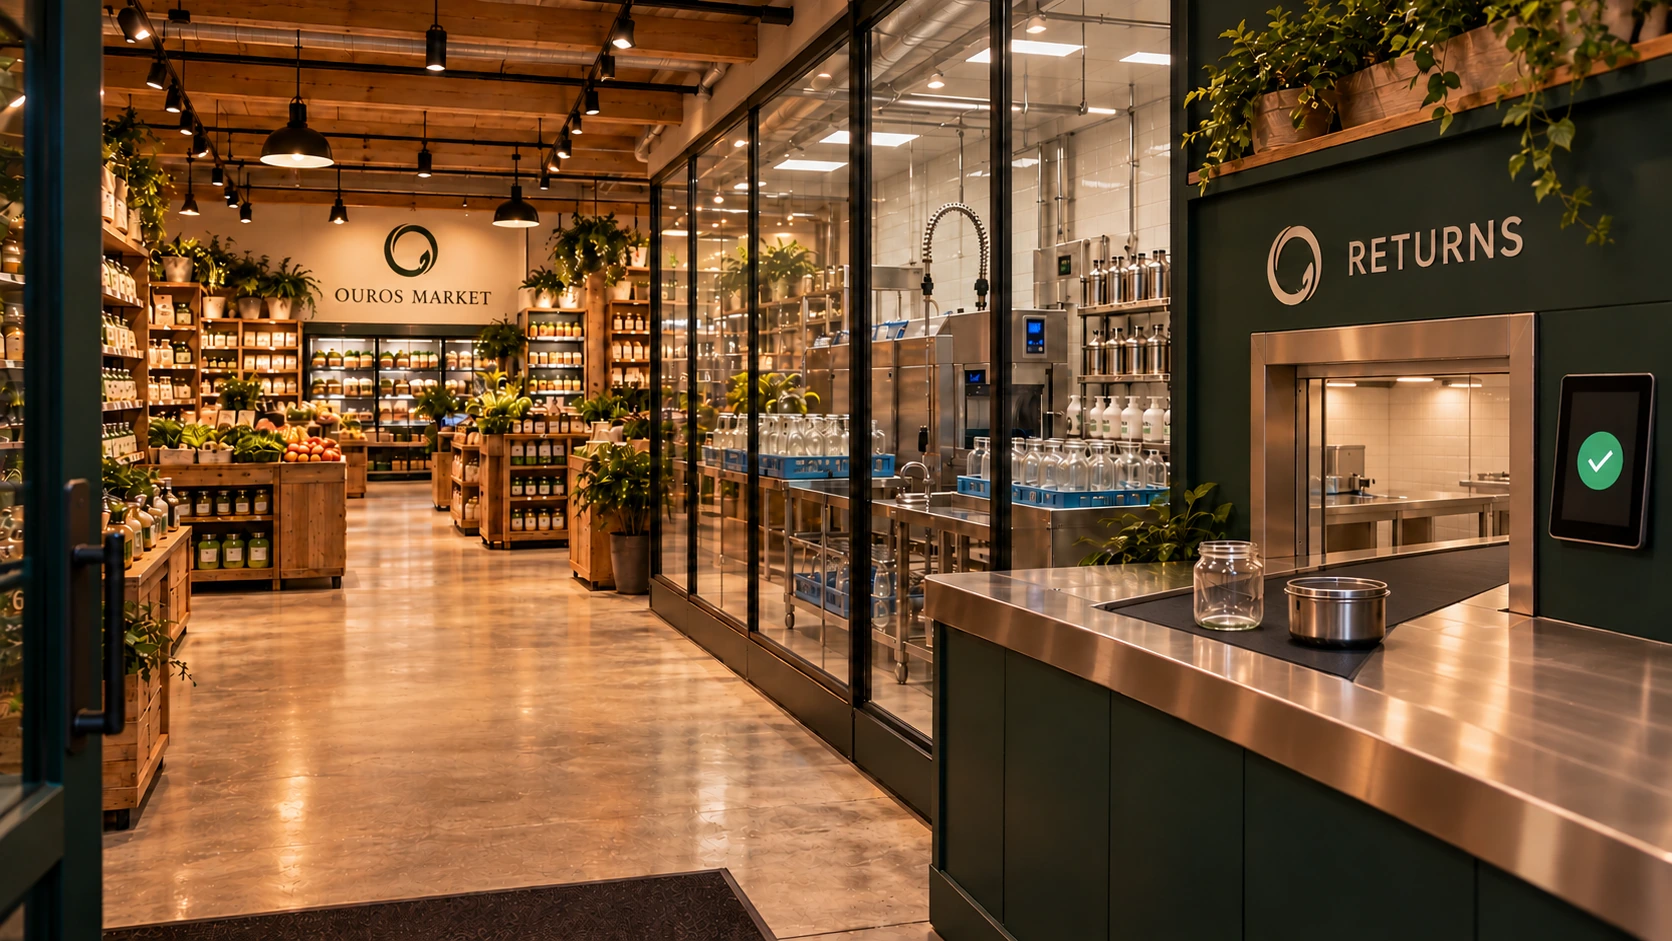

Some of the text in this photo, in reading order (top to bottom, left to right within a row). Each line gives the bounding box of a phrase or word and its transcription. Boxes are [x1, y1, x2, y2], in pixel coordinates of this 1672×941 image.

[1348, 215, 1524, 276] RETURNS
[334, 287, 492, 306] OUROS MARKET
